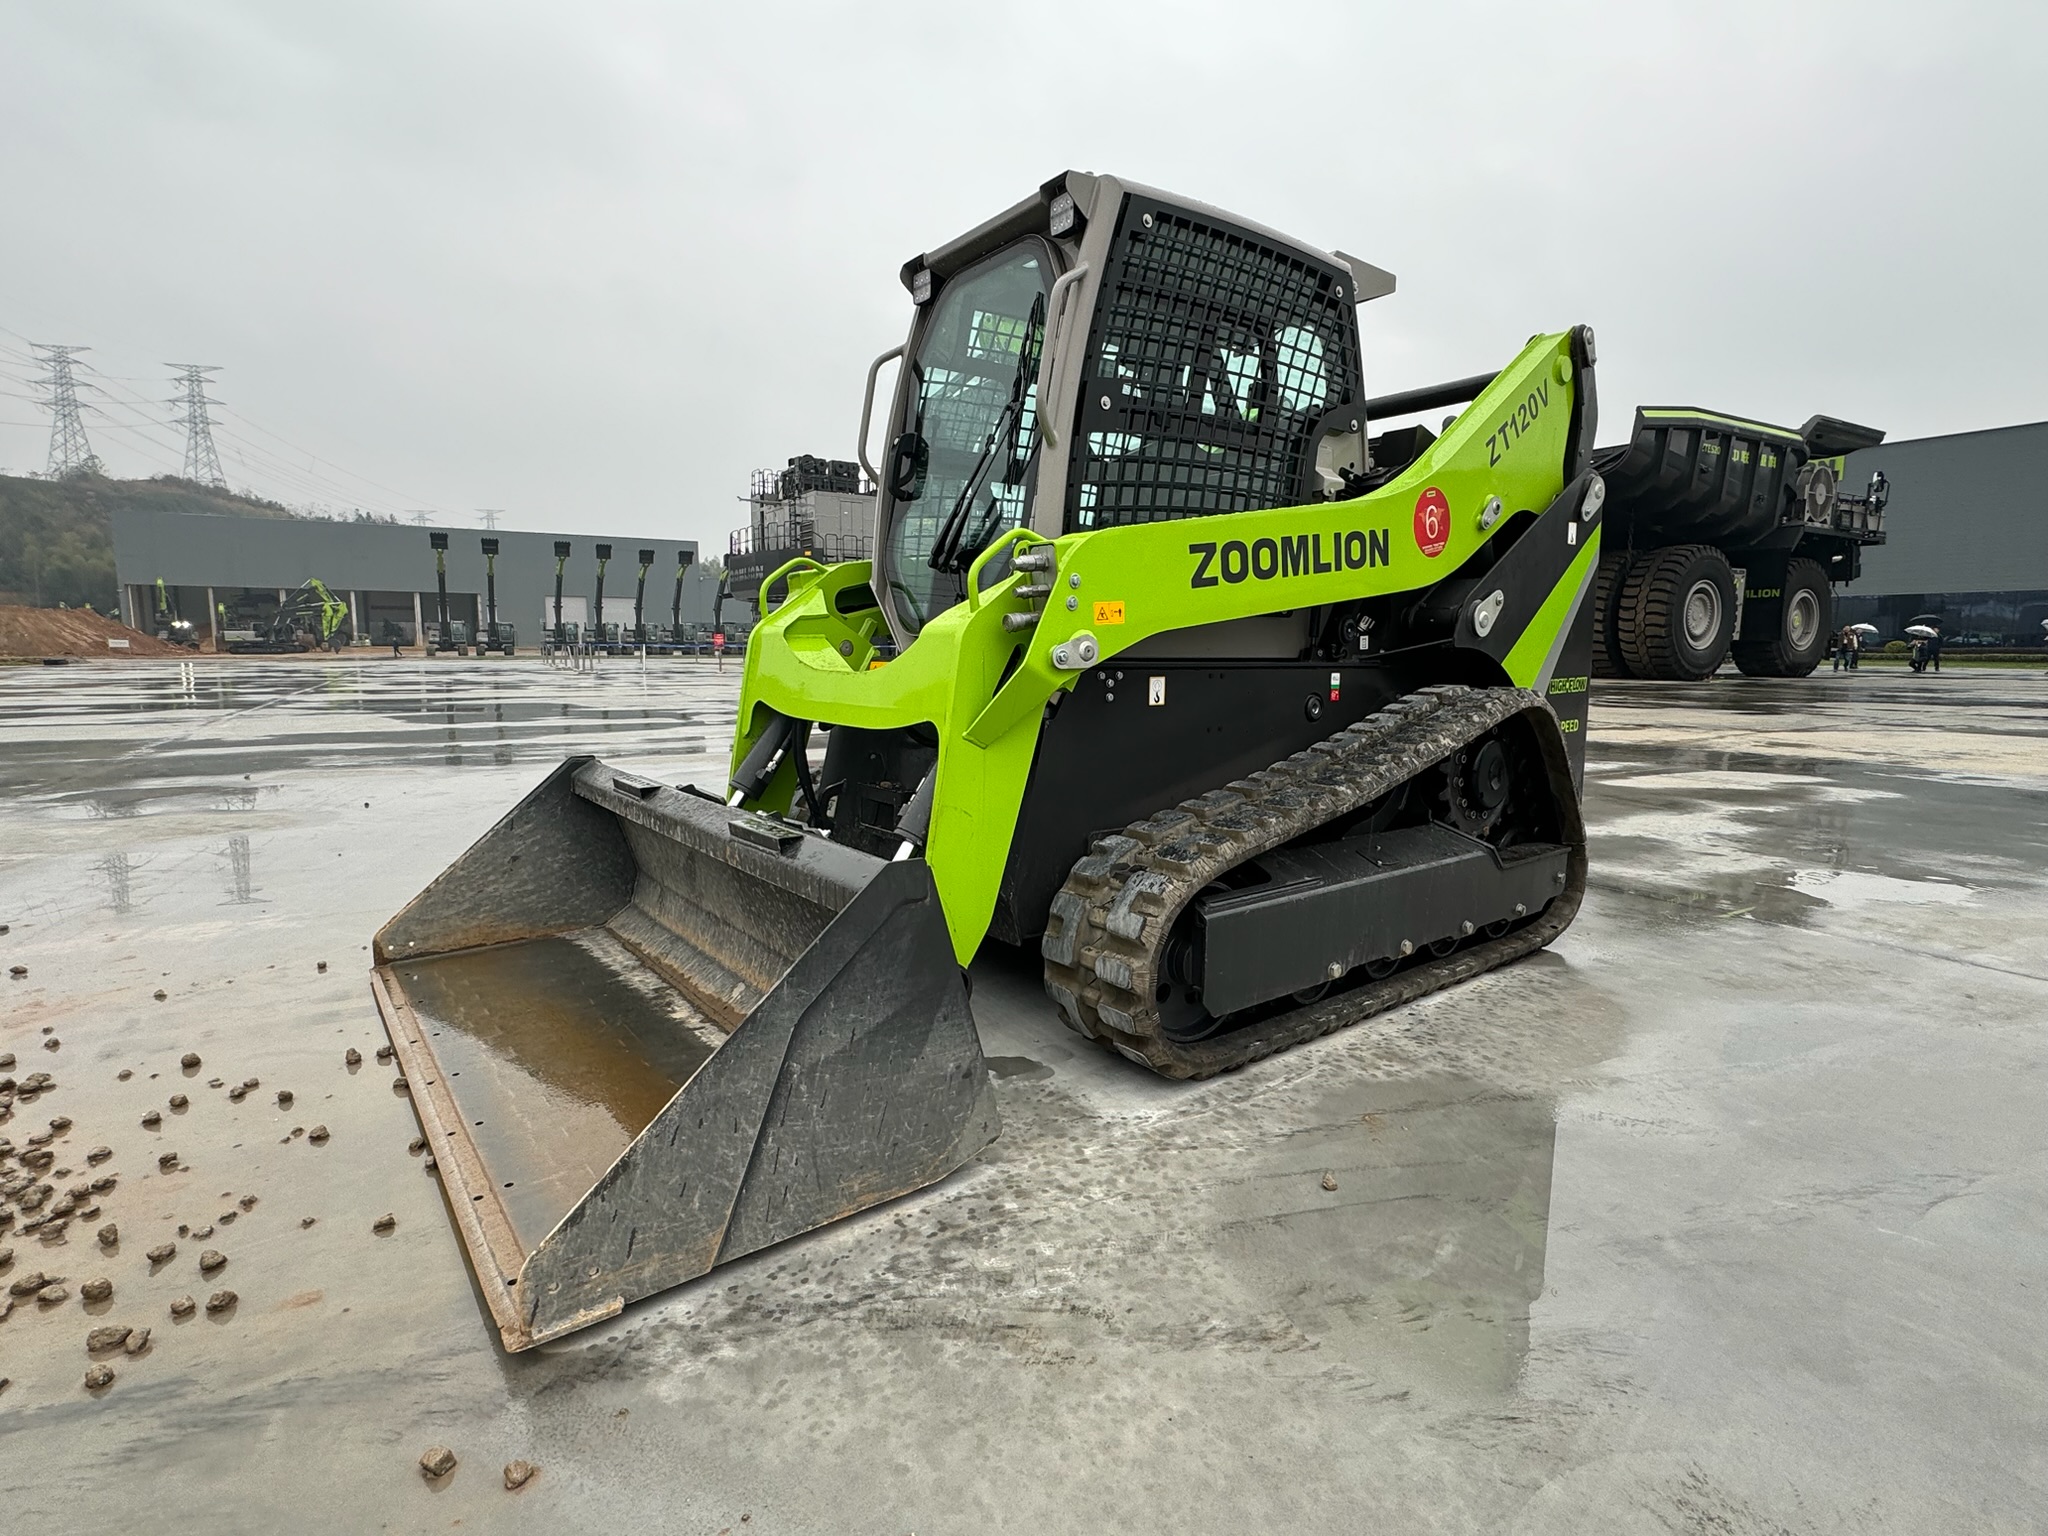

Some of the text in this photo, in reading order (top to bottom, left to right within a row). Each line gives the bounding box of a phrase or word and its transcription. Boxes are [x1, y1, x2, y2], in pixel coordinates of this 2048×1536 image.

[1485, 378, 1551, 469] ZT120V
[1425, 504, 1439, 539] 6
[1189, 528, 1390, 589] ZOOMLION
[1744, 588, 1780, 598] LION
[1560, 719, 1579, 733] PEED
